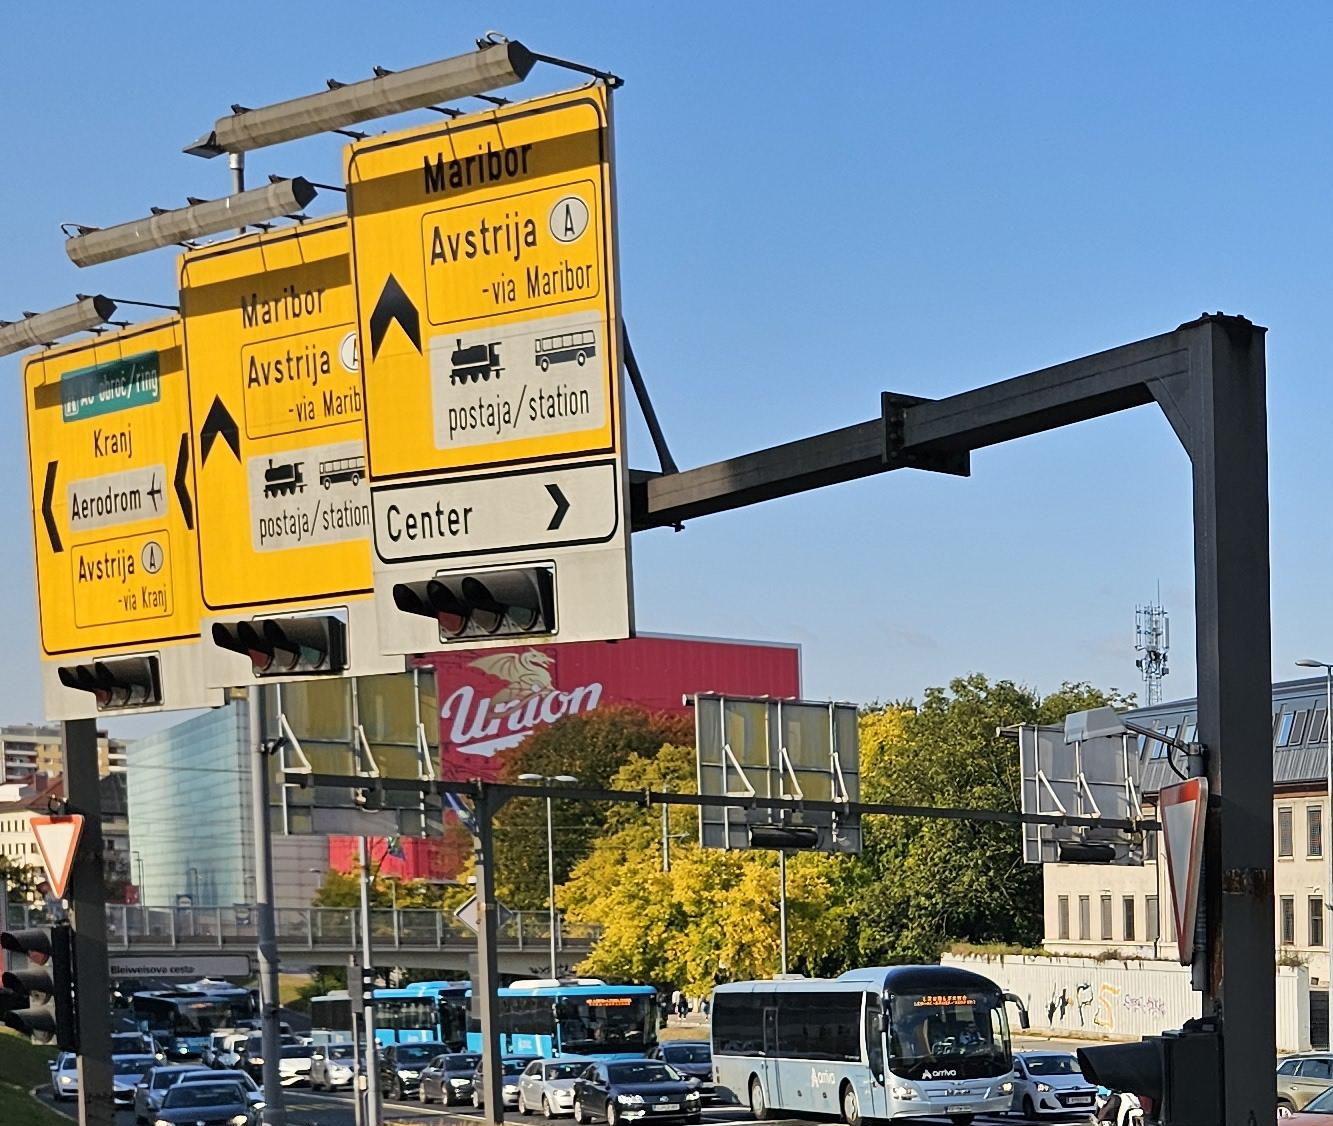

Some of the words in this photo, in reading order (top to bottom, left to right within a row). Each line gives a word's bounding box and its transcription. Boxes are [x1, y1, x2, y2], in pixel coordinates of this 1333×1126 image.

[423, 142, 533, 195] Maribor
[430, 211, 538, 266] Avstrija
[482, 272, 516, 305] -via
[525, 259, 592, 299] Maribor
[241, 284, 325, 329] Maribor
[247, 344, 331, 389] Avstrija
[288, 395, 315, 422] -via
[448, 384, 590, 440] postaja/station
[93, 422, 133, 459] Kranj
[71, 486, 142, 521] Aerodrom
[259, 499, 370, 546] postaja/station
[387, 500, 473, 542] Center
[78, 548, 135, 584] Avstrija
[142, 584, 167, 613] Kranj
[441, 682, 603, 744] Union
[932, 1068, 957, 1077] arriva
